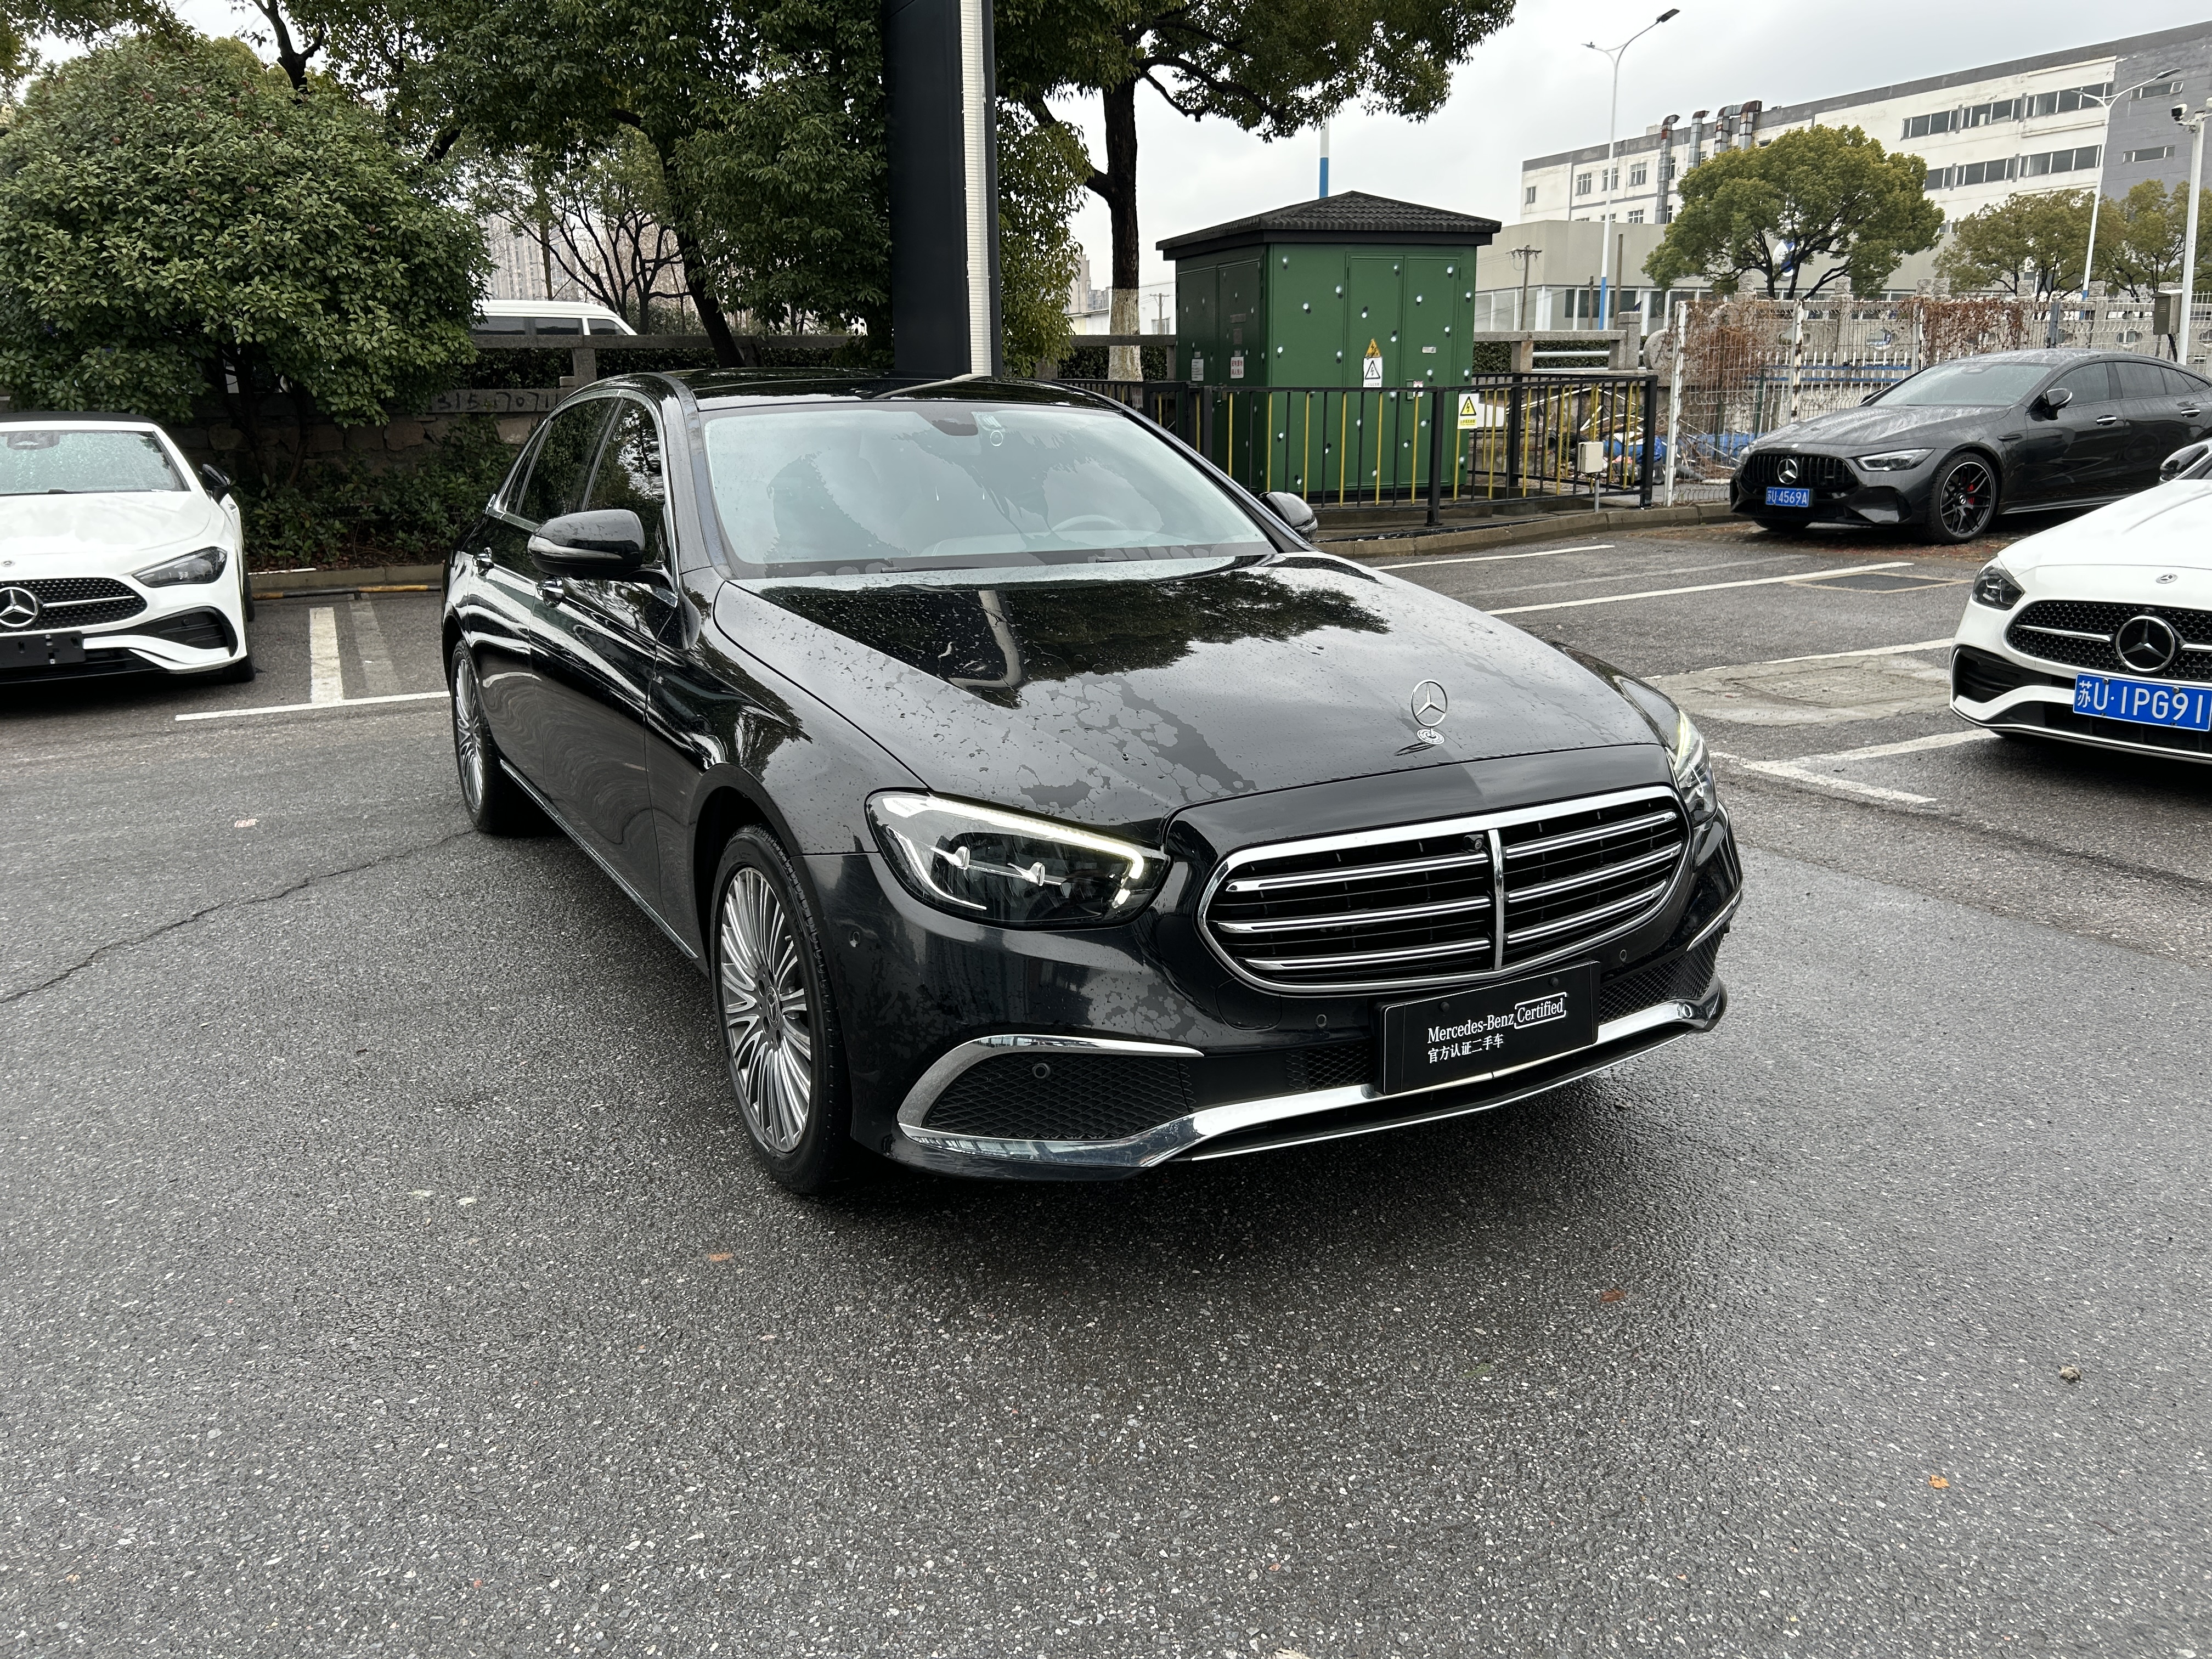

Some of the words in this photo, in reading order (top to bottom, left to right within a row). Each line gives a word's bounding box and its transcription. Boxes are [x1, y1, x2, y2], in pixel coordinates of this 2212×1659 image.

[2077, 680, 2203, 724] 苏U·1PG91
[1427, 1013, 1515, 1043] Mercedes-Benz
[1517, 998, 1564, 1023] Certified
[1427, 1034, 1504, 1064] 官方认证二手车
